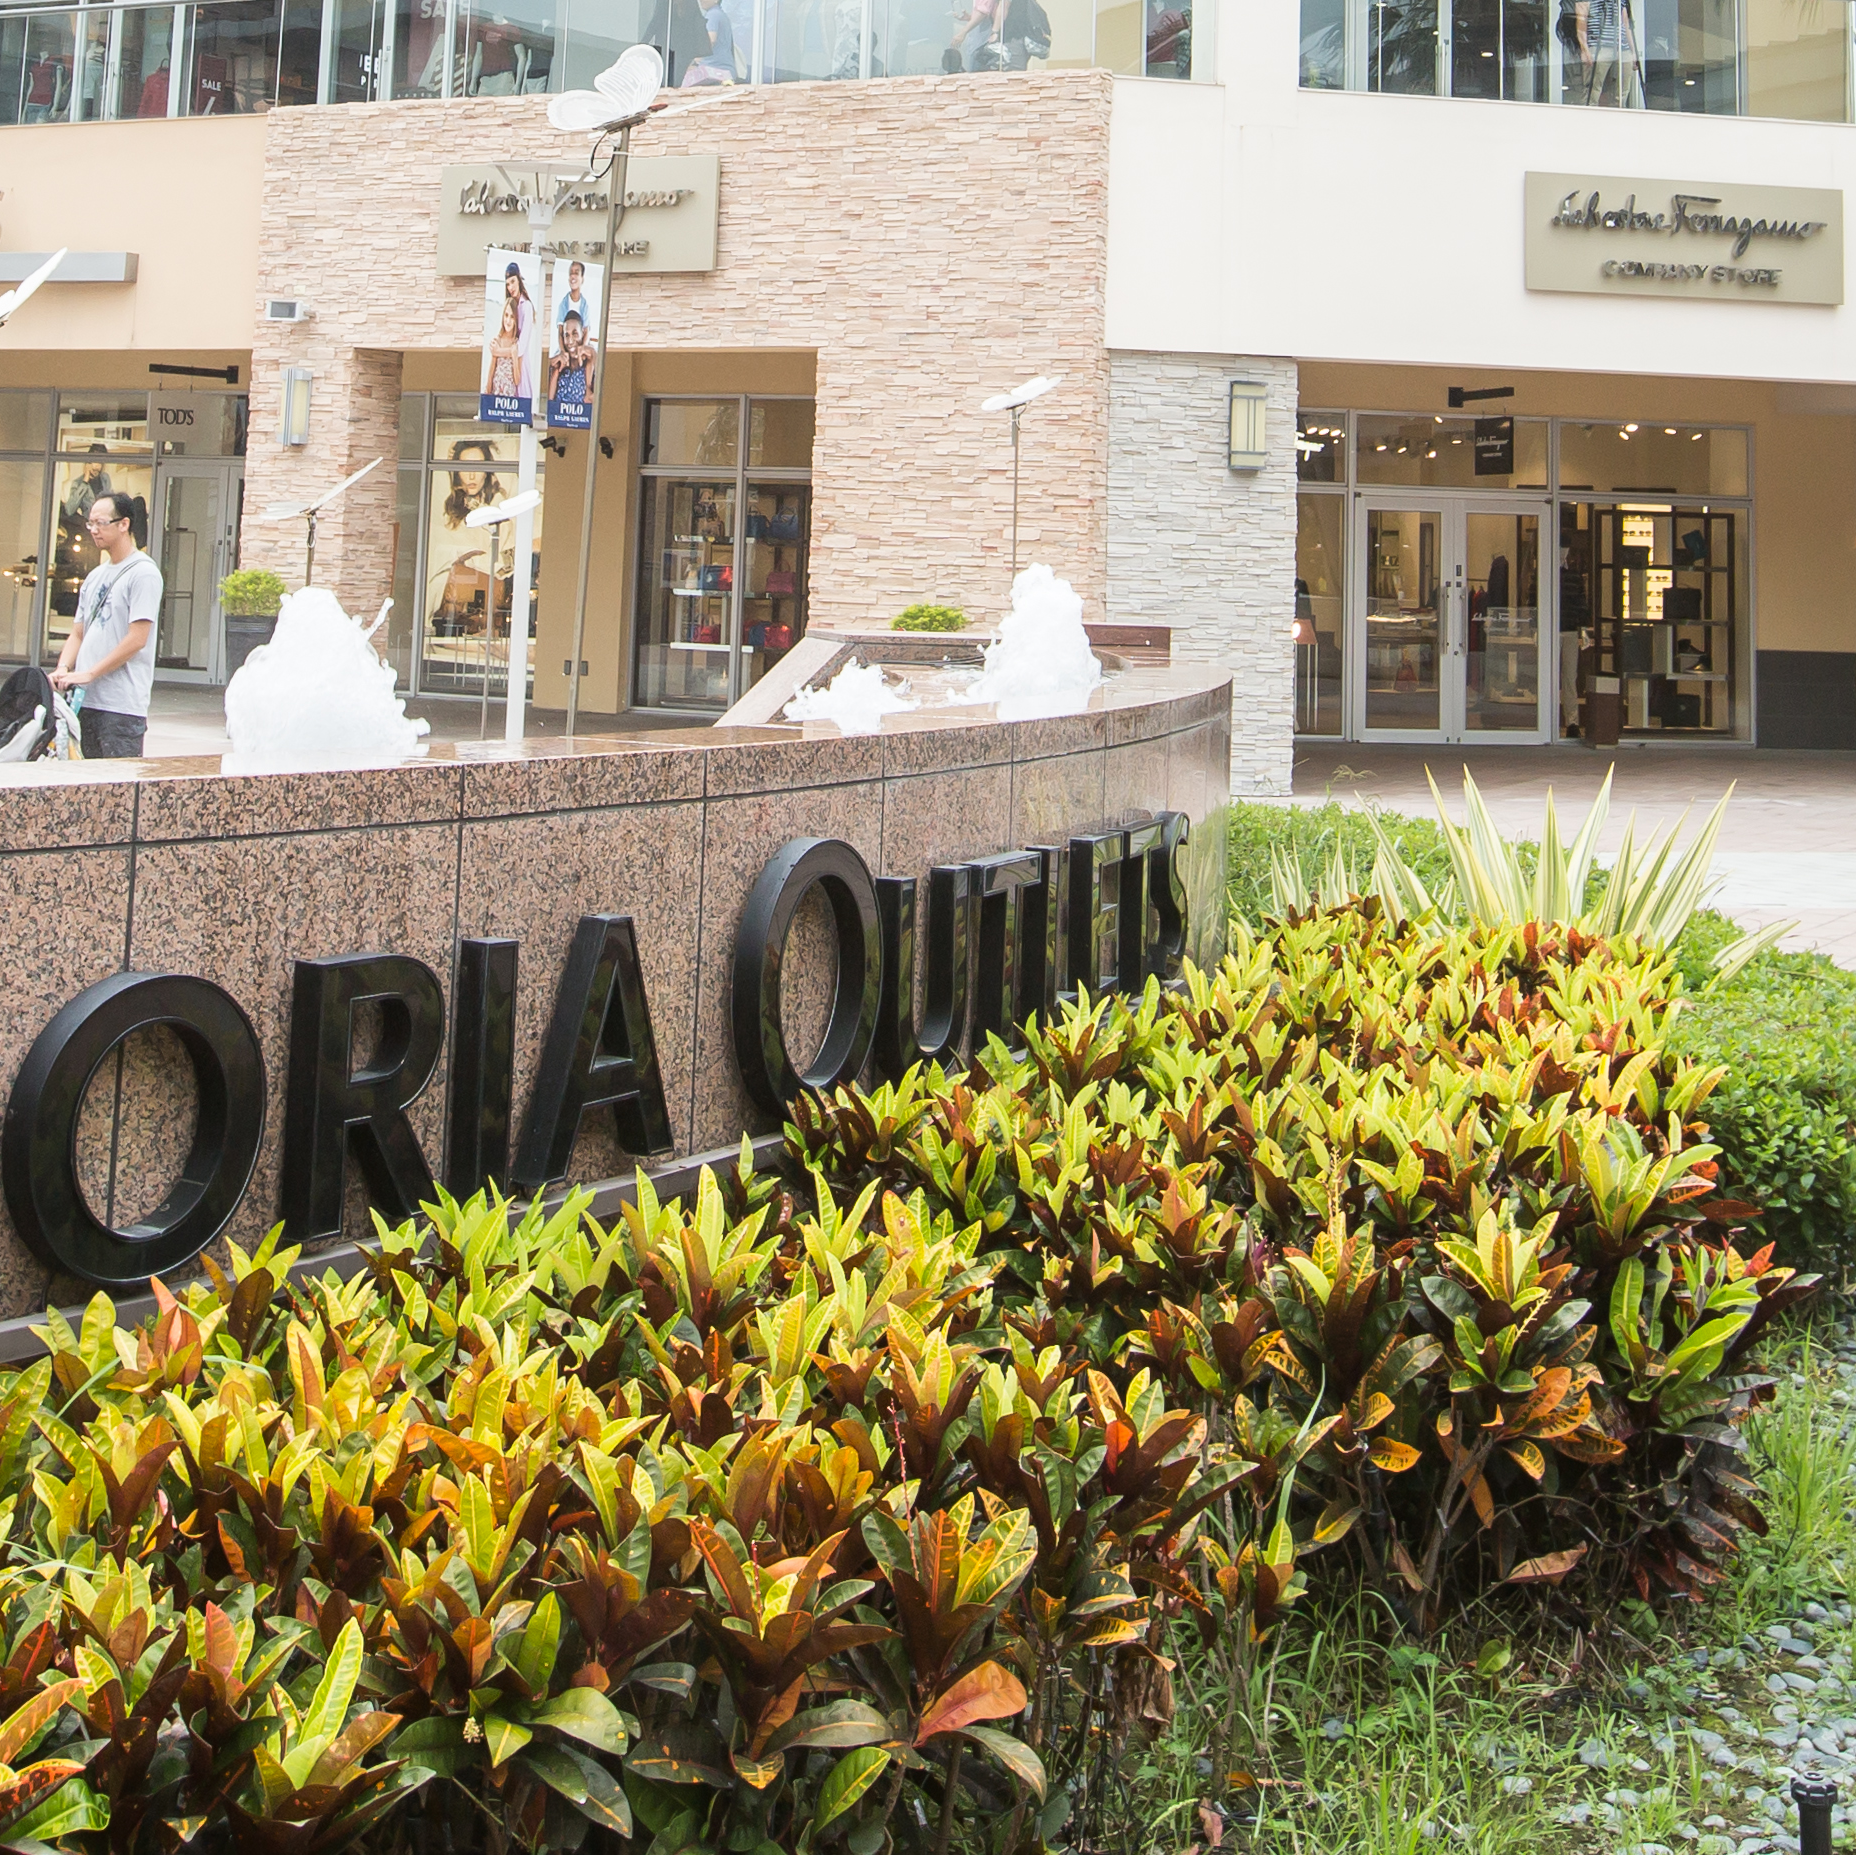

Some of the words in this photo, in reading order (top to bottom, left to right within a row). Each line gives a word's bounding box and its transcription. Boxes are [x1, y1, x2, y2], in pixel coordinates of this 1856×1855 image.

[201, 77, 222, 92] SALE
[583, 240, 650, 256] STRE
[1601, 259, 1710, 281] COMPANY
[1710, 265, 1783, 287] STORE
[494, 396, 519, 411] POLO
[560, 402, 583, 415] POLO
[157, 407, 194, 426] TOD'S
[731, 810, 1191, 1122] OUTLETS
